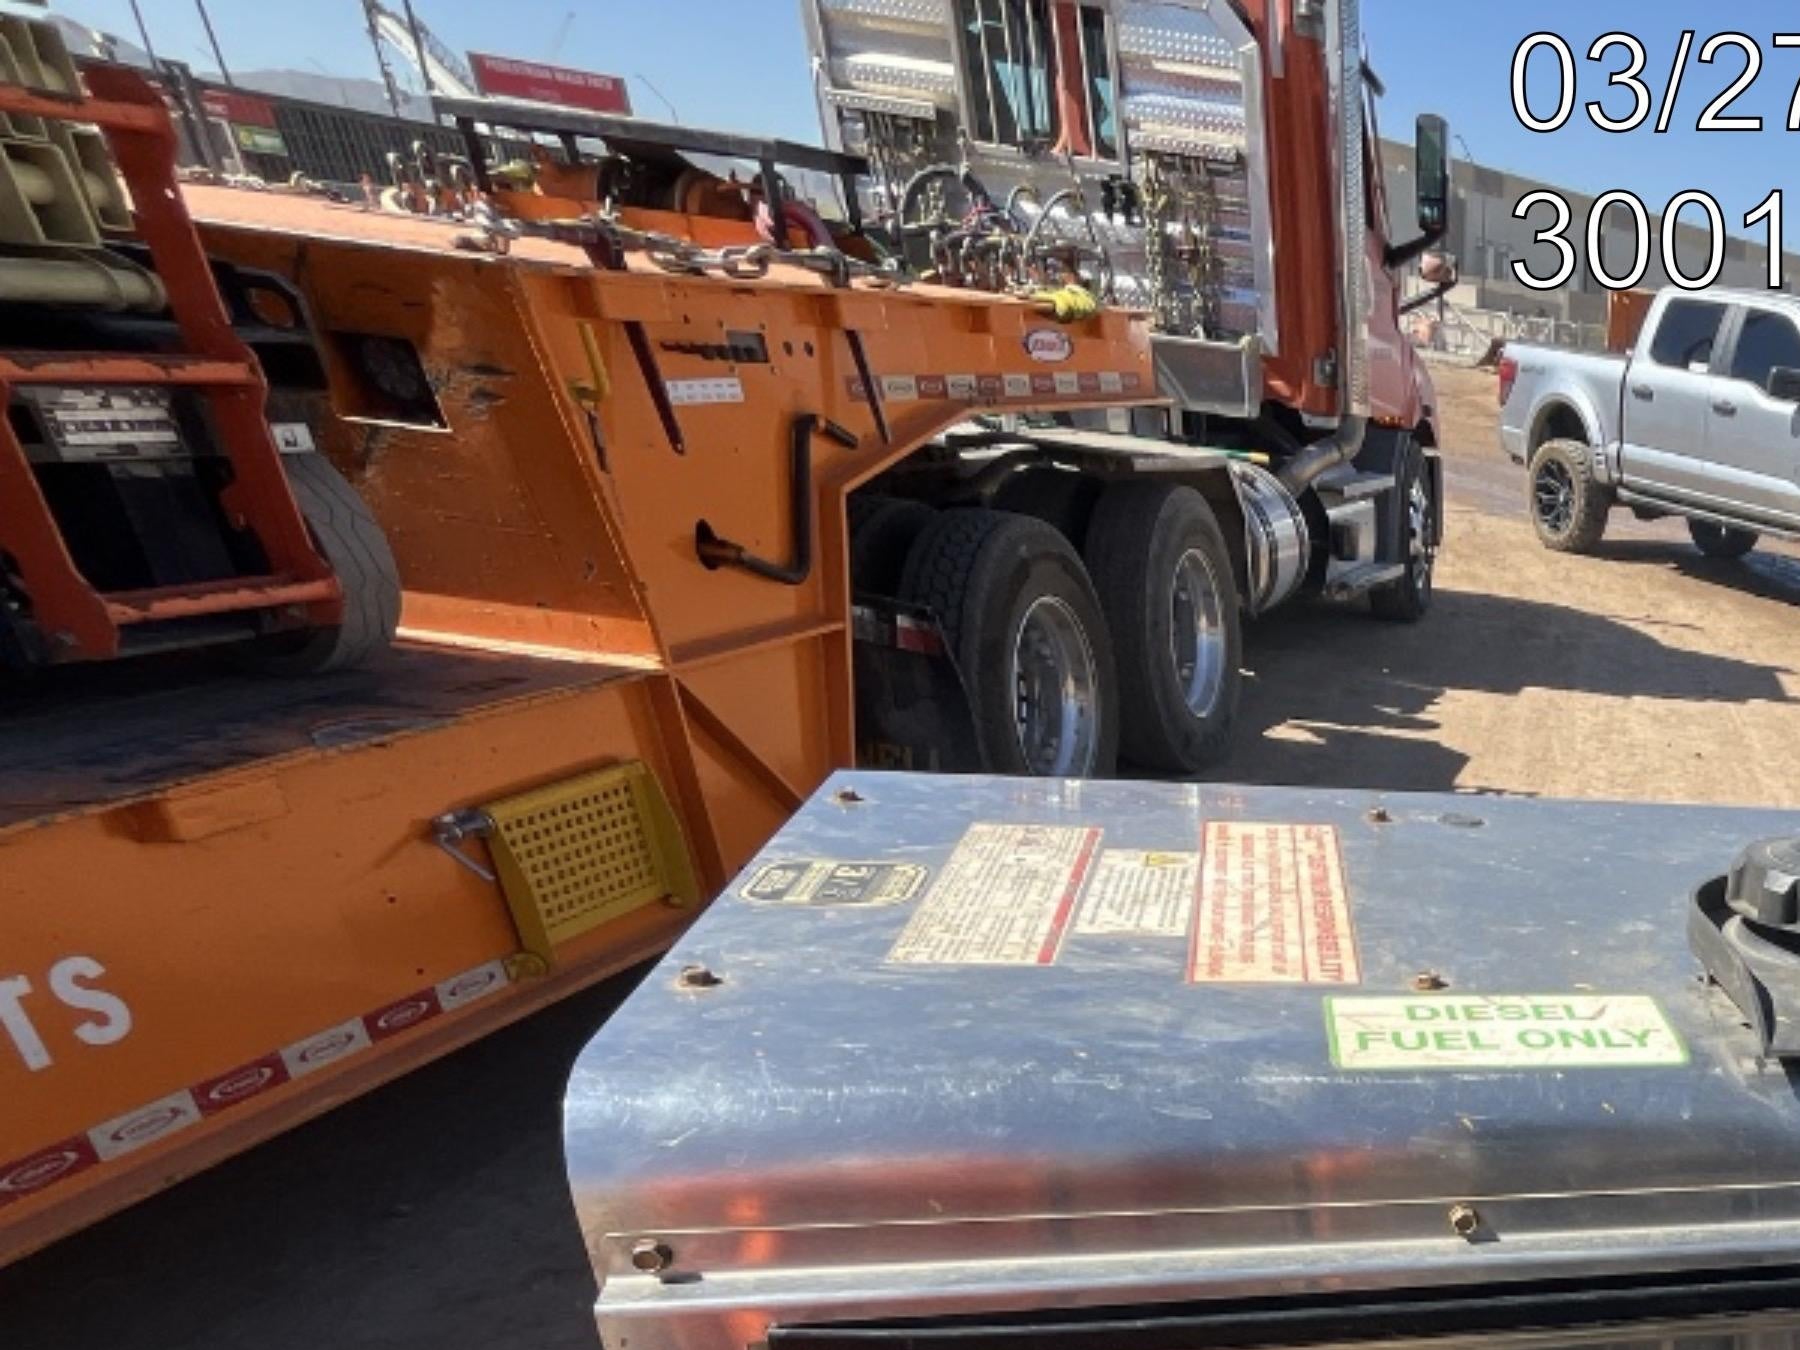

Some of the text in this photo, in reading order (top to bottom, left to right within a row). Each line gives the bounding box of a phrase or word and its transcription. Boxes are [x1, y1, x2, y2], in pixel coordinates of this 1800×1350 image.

[1404, 1003, 1595, 1022] DIESEL
[1357, 1028, 1660, 1051] FUEL ONLY
